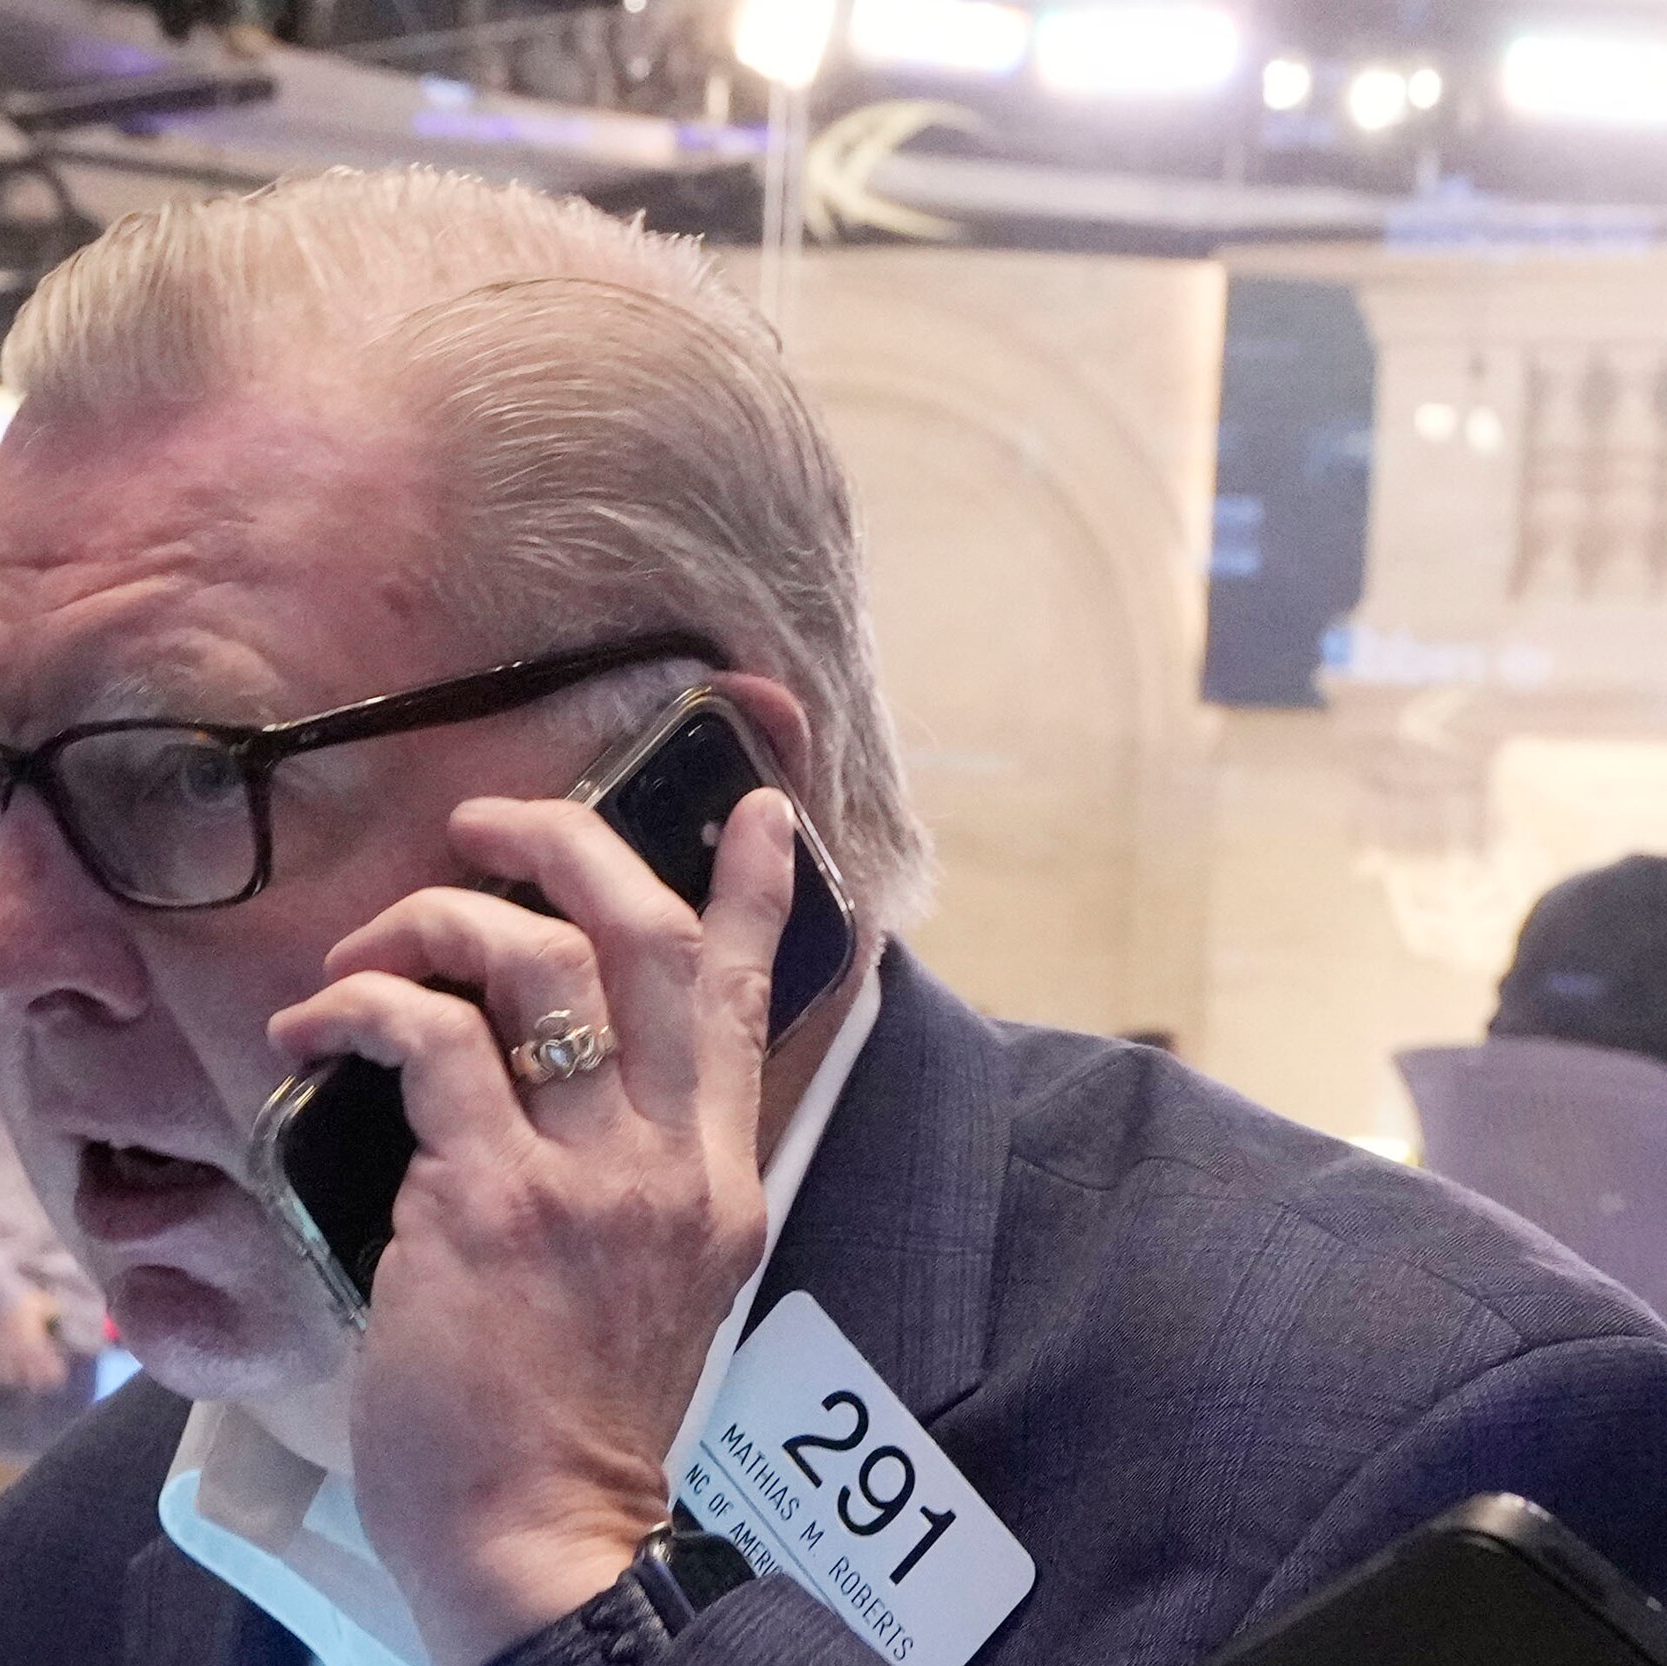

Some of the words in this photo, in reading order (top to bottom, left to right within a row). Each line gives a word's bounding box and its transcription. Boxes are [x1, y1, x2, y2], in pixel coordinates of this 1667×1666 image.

[708, 1492, 734, 1518] OF
[721, 1422, 800, 1521] MATHIAS
[799, 1520, 825, 1558] M.
[828, 1556, 914, 1662] ROBERTS
[782, 1389, 957, 1587] 291
